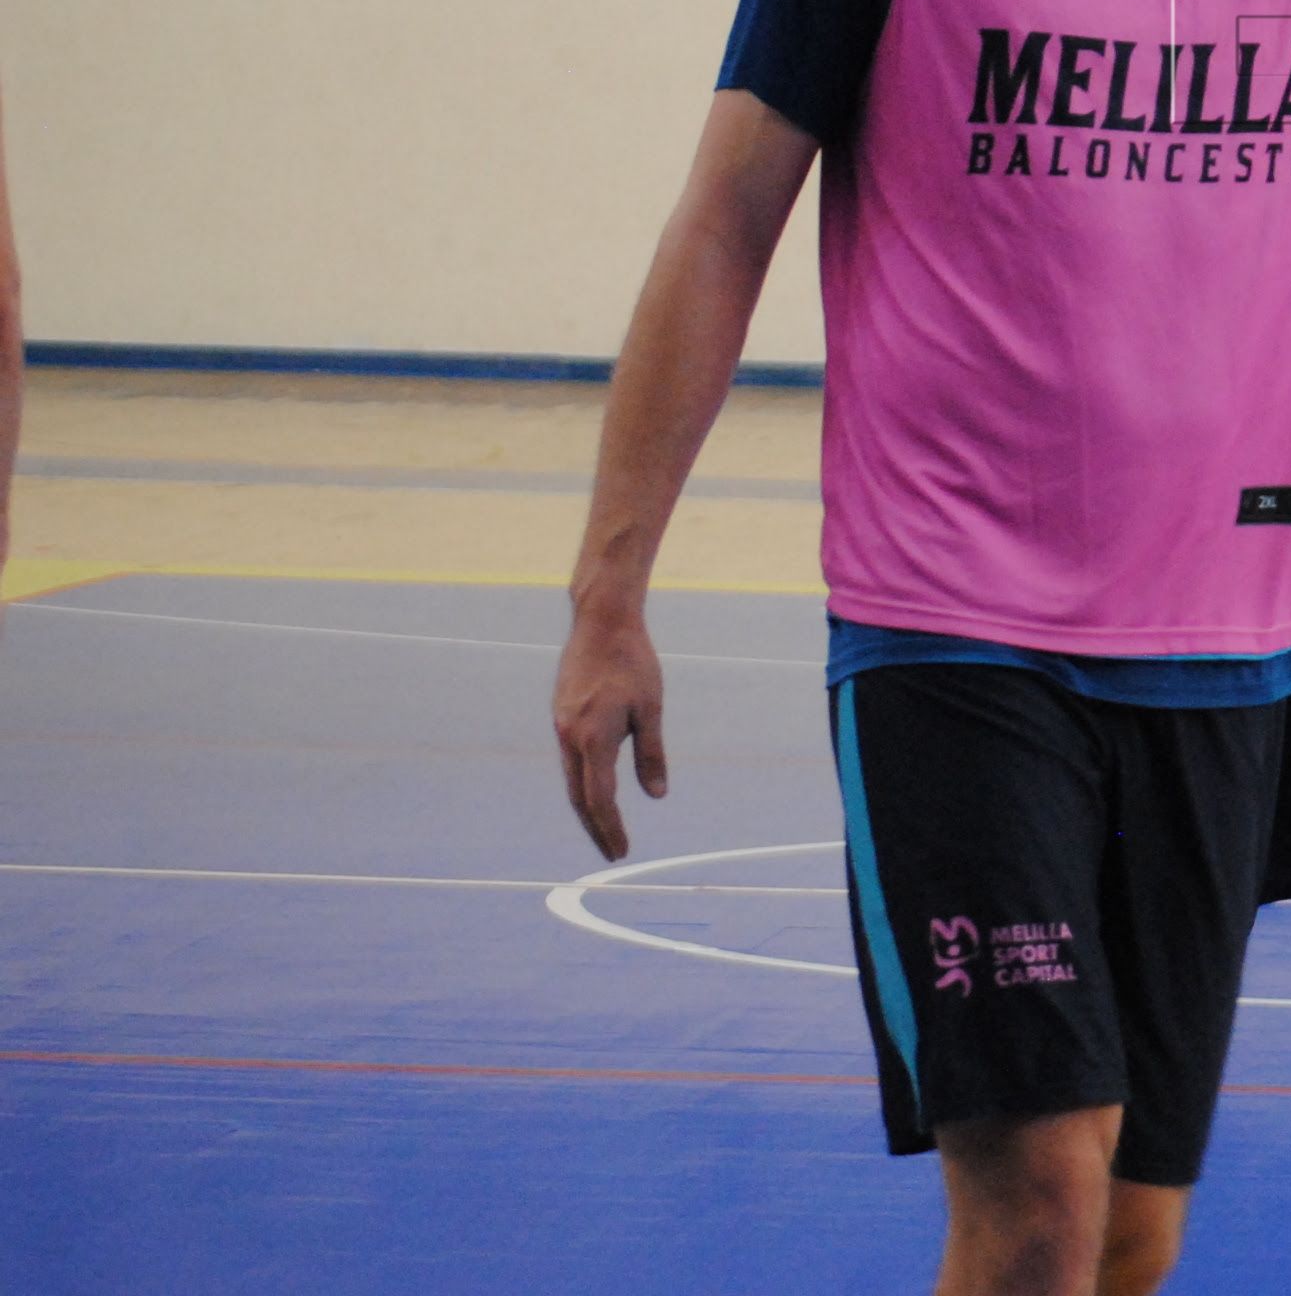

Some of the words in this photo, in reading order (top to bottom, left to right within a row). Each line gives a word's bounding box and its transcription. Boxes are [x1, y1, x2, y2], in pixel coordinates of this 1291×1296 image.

[990, 921, 1073, 943] MELILLA
[993, 942, 1059, 965] SPORT
[994, 963, 1077, 987] CAPITAL
